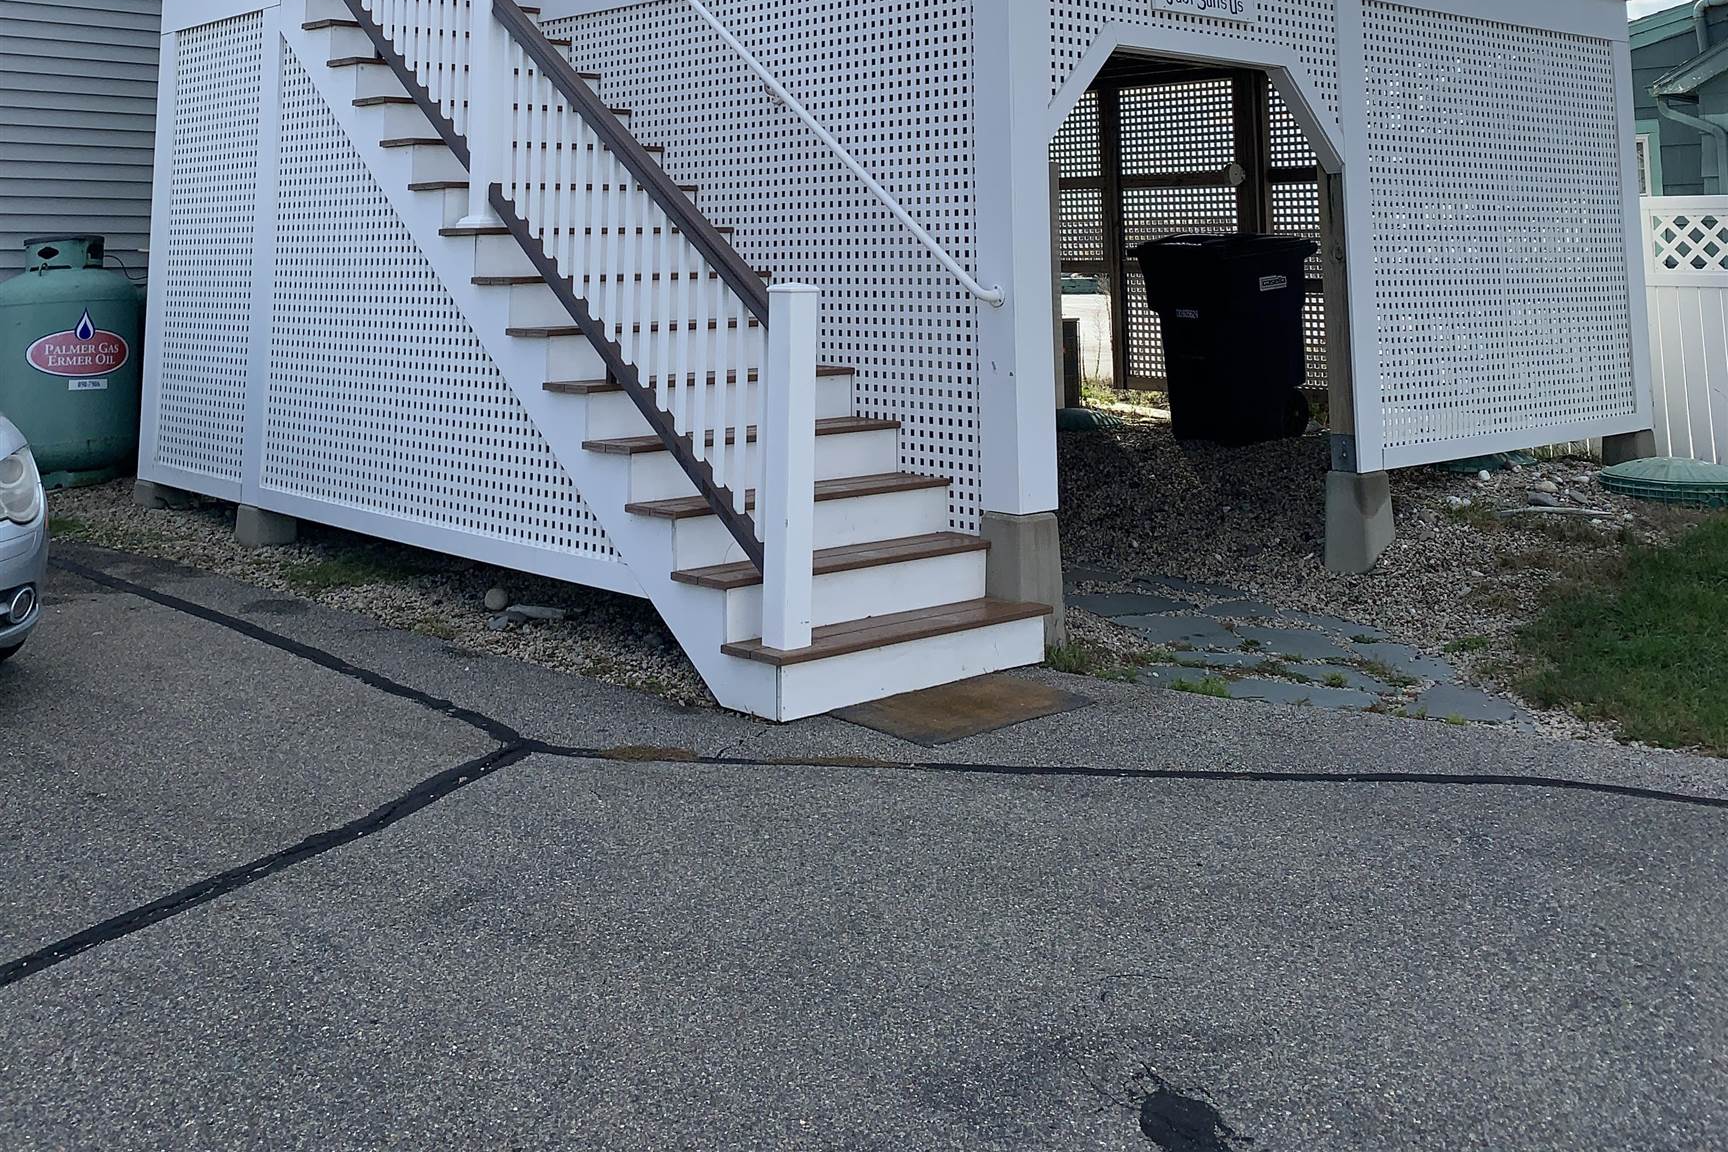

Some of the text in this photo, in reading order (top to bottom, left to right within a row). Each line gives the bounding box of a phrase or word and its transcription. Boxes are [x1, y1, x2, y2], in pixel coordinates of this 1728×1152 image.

[44, 342, 119, 356] PALMER GAS
[48, 353, 116, 367] ERMER OIL
